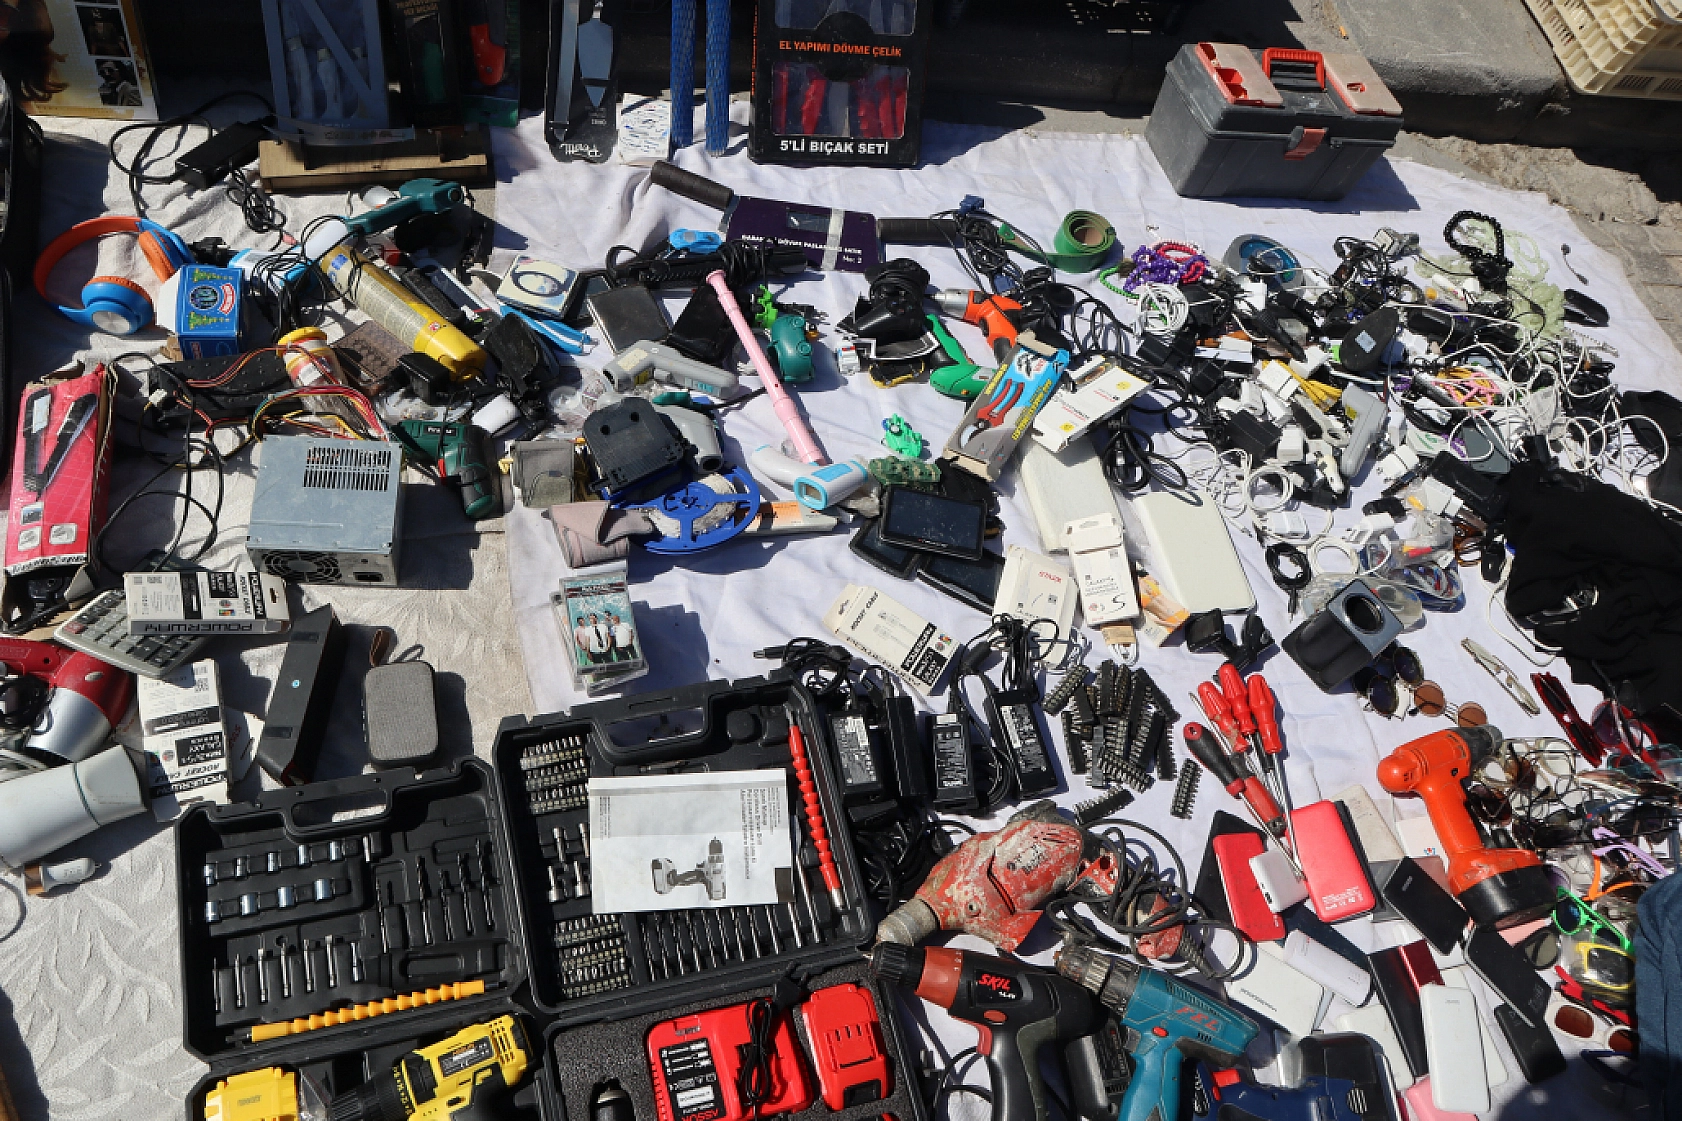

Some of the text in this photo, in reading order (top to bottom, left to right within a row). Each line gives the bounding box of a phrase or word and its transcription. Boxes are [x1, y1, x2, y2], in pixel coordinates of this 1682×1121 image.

[779, 41, 902, 58] EL YAPIMI DÖVME ÇELİK
[779, 138, 889, 155] 5'Lİ BIÇAK SETİ
[144, 623, 253, 632] POWERWAY
[978, 973, 1011, 992] SKIL
